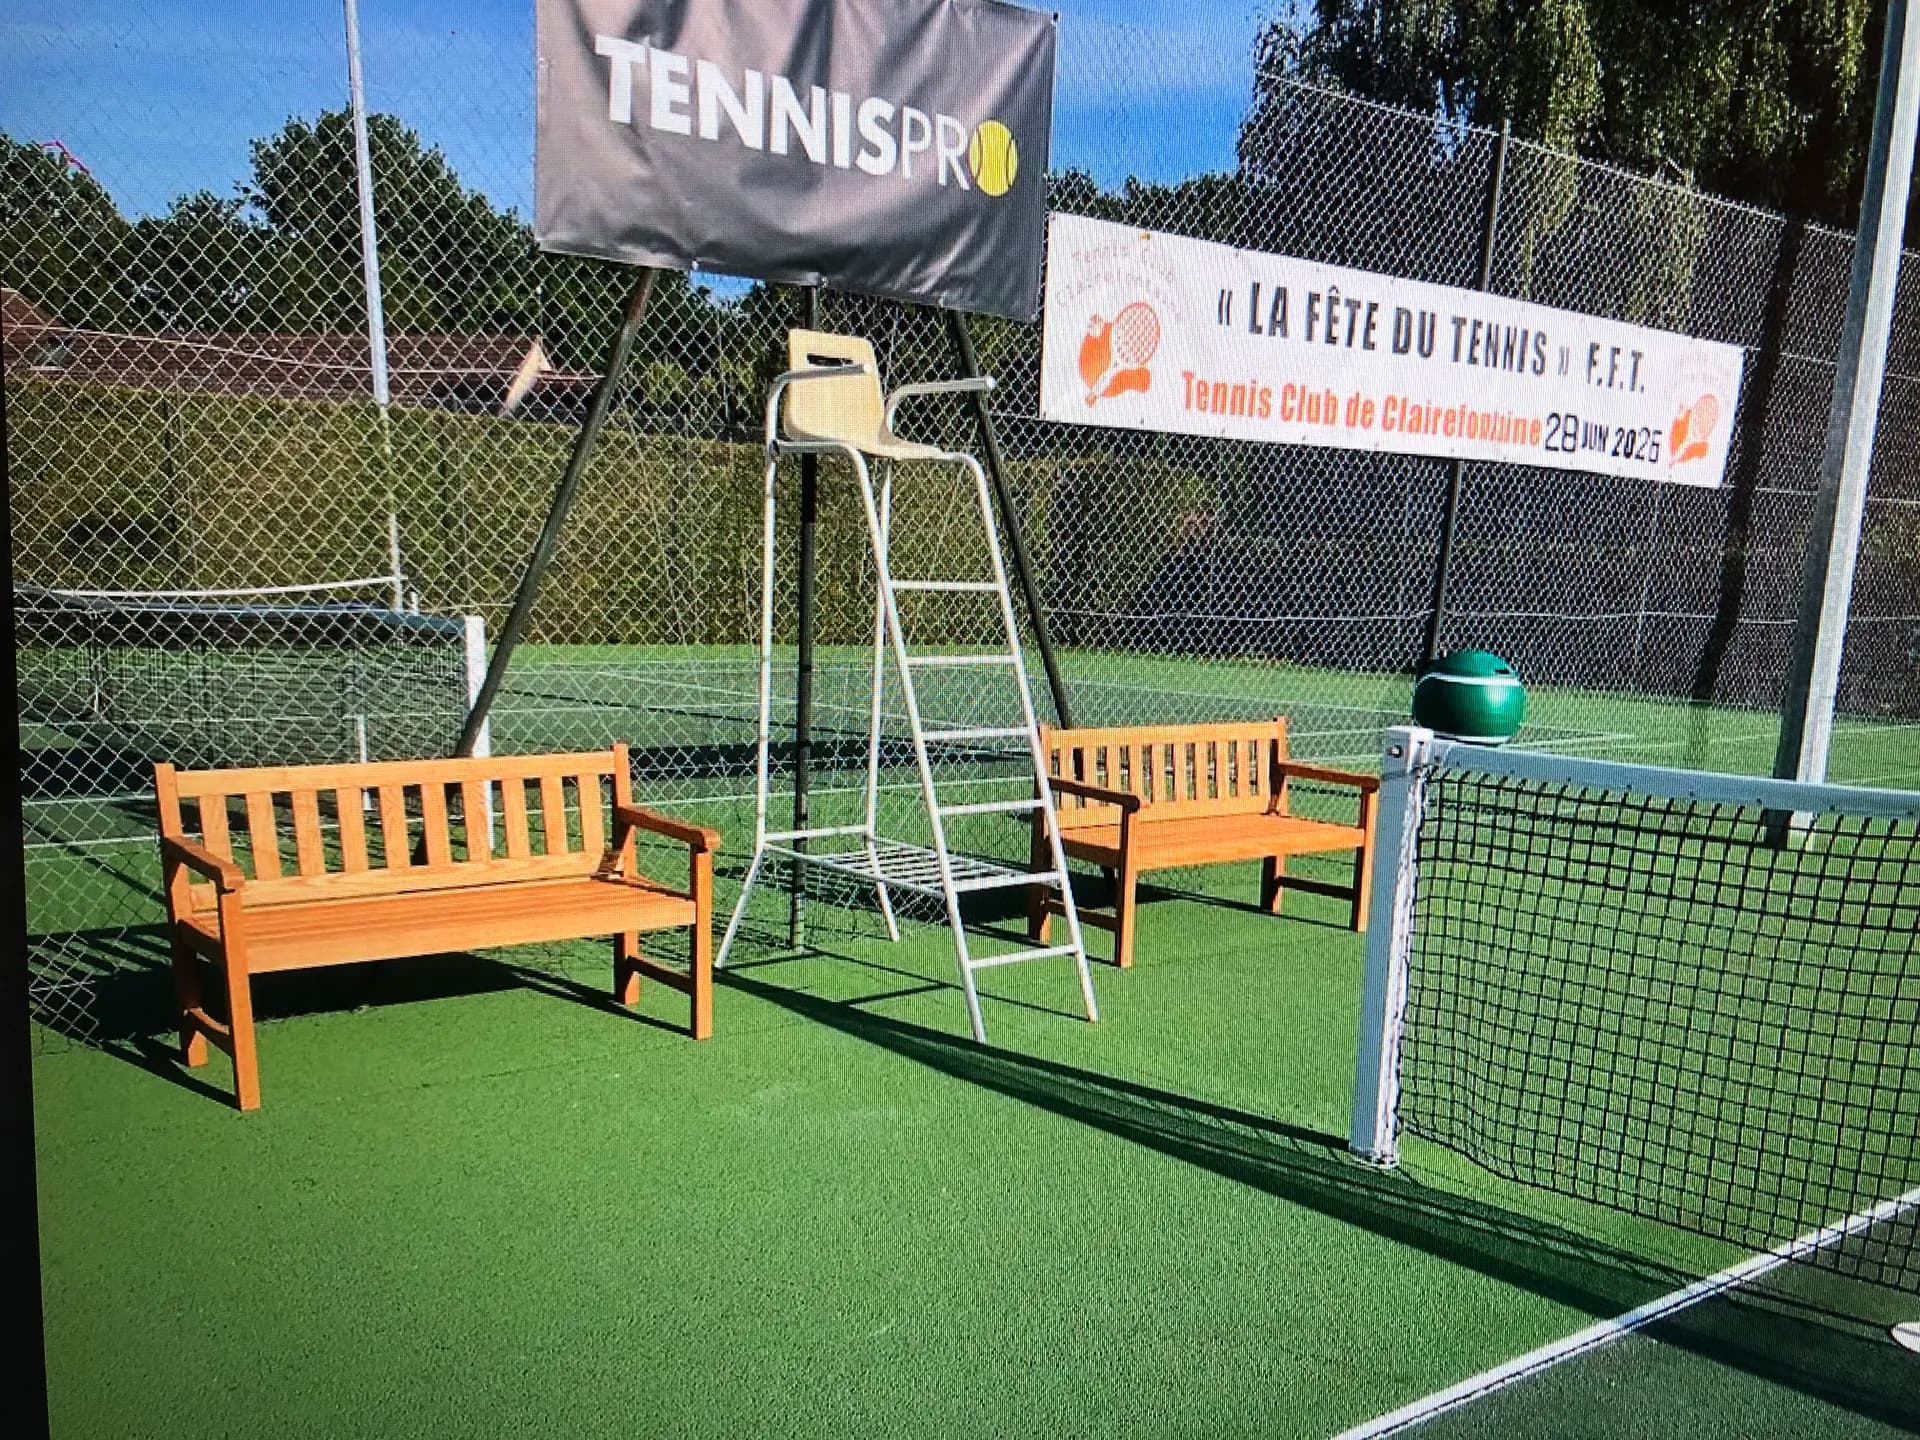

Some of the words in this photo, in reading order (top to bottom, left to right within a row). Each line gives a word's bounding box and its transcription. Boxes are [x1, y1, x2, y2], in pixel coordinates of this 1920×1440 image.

[1248, 281, 1289, 337] LA
[1304, 285, 1379, 350] FÊTE
[1391, 306, 1436, 358] DU
[1451, 315, 1546, 376] TENNIS
[1586, 342, 1645, 393] F.F.T.
[1182, 370, 1272, 419] Tennis
[1280, 382, 1338, 425] Club
[1345, 391, 1375, 429] de
[1544, 412, 1579, 453] 28
